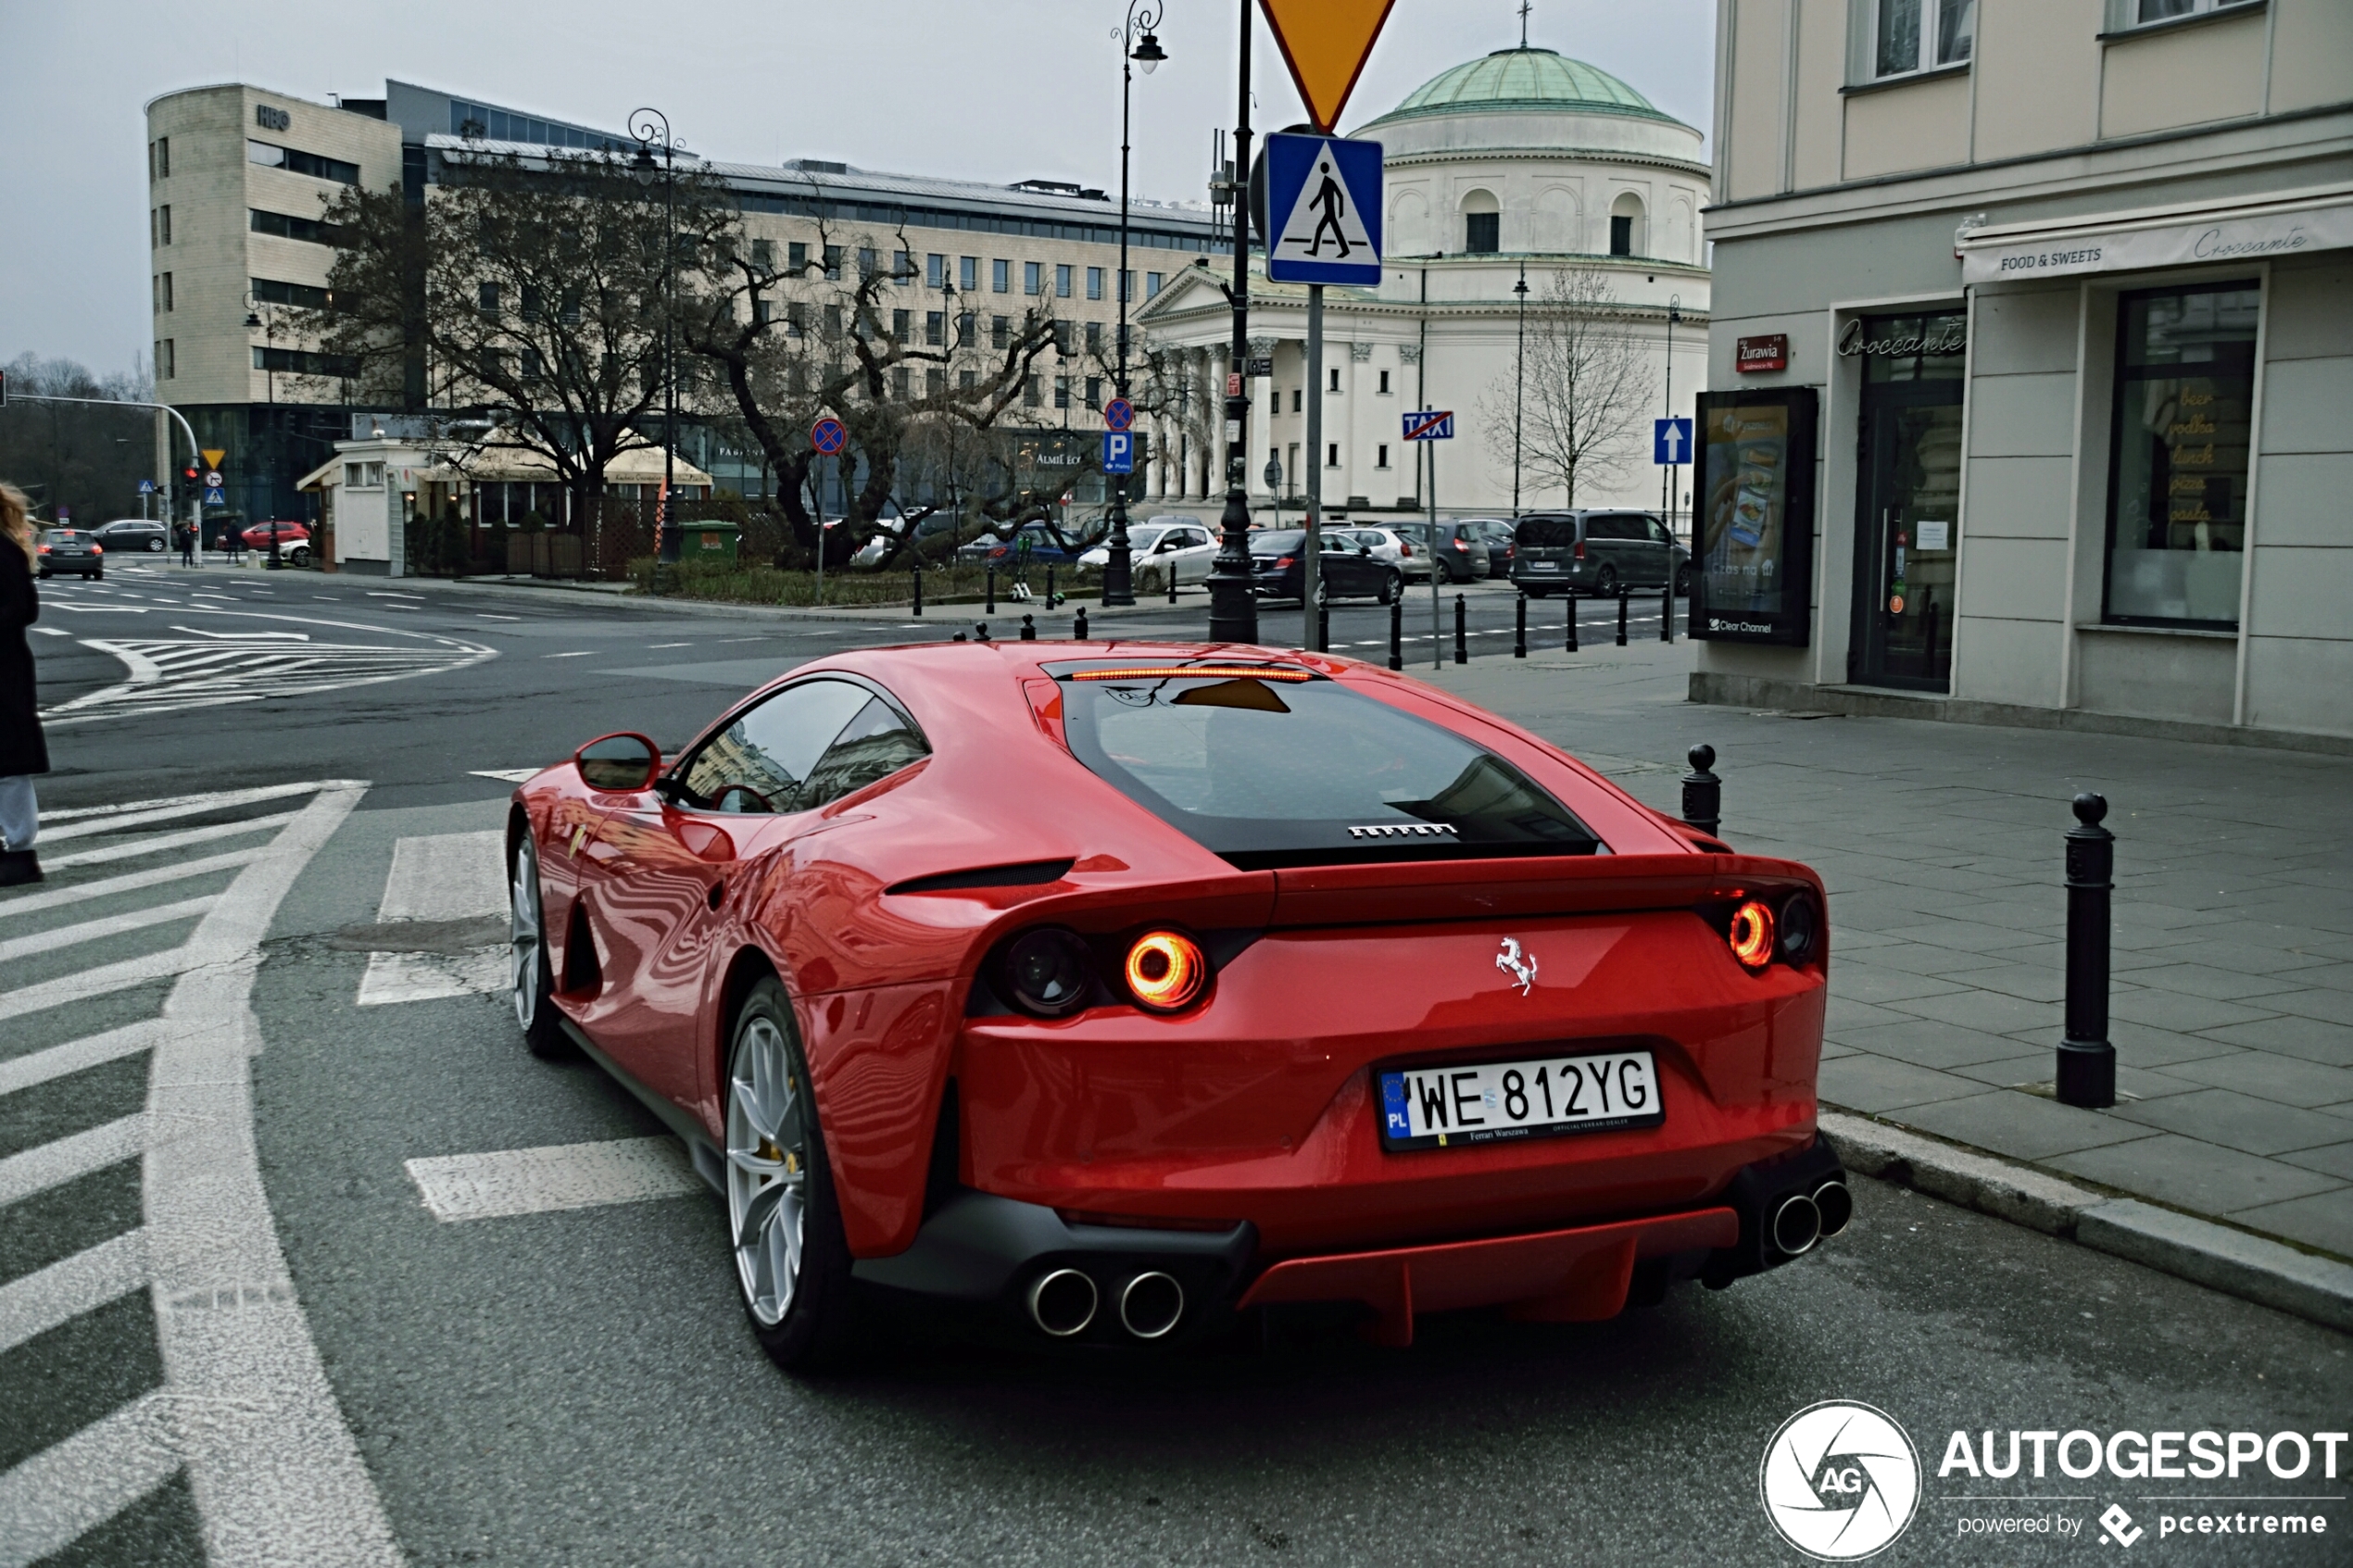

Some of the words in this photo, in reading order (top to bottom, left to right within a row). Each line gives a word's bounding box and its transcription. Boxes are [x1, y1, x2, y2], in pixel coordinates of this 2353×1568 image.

[258, 104, 291, 132] HBO
[2195, 228, 2308, 258] Croccante
[2001, 257, 2035, 270] FOOD
[2038, 254, 2047, 267] &
[2051, 248, 2102, 266] SWEETS
[1837, 319, 1966, 356] Croccante
[1741, 344, 1778, 359] Żurawia
[2180, 386, 2213, 406] beer
[1404, 415, 1451, 437] TAXI
[2169, 414, 2216, 434] vodka
[1110, 435, 1127, 461] P
[2173, 444, 2214, 464] lunch
[2170, 474, 2207, 495] pizza
[1712, 562, 1739, 574] Czas
[1743, 565, 1757, 575] na
[1719, 621, 1740, 631] Clear
[1740, 621, 1771, 633] Channel
[1416, 1072, 1485, 1129] WE
[1503, 1059, 1647, 1121] 812YG
[1390, 1113, 1407, 1128] PL
[1553, 1123, 1580, 1132] OFFICIAL
[1580, 1121, 1605, 1129] FERRARI
[1605, 1118, 1629, 1126] DEALER
[1469, 1131, 1493, 1141] Ferrari
[1493, 1128, 1529, 1137] Warszawa
